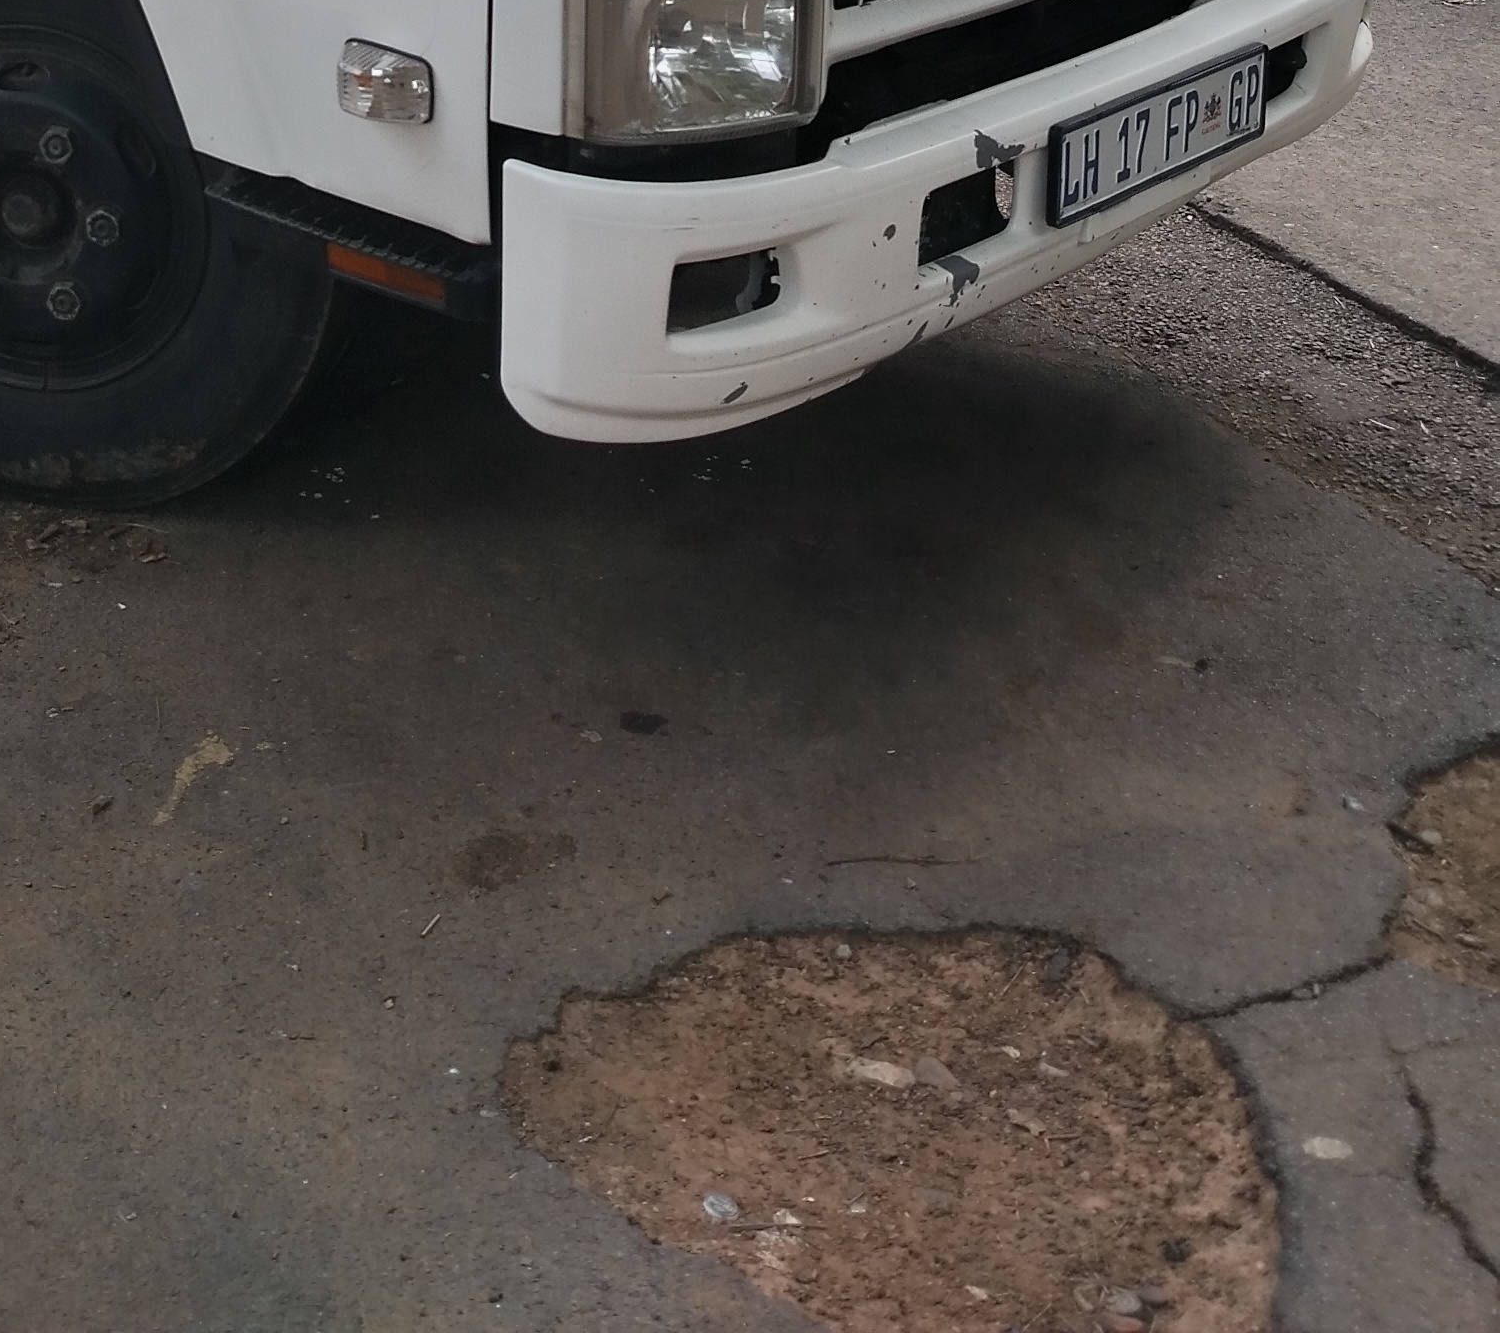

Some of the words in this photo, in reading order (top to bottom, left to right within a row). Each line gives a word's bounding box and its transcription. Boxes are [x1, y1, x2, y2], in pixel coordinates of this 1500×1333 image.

[1062, 128, 1100, 208] LH
[1116, 107, 1150, 184] 17
[1163, 89, 1199, 162] FP
[1227, 64, 1260, 132] GP
